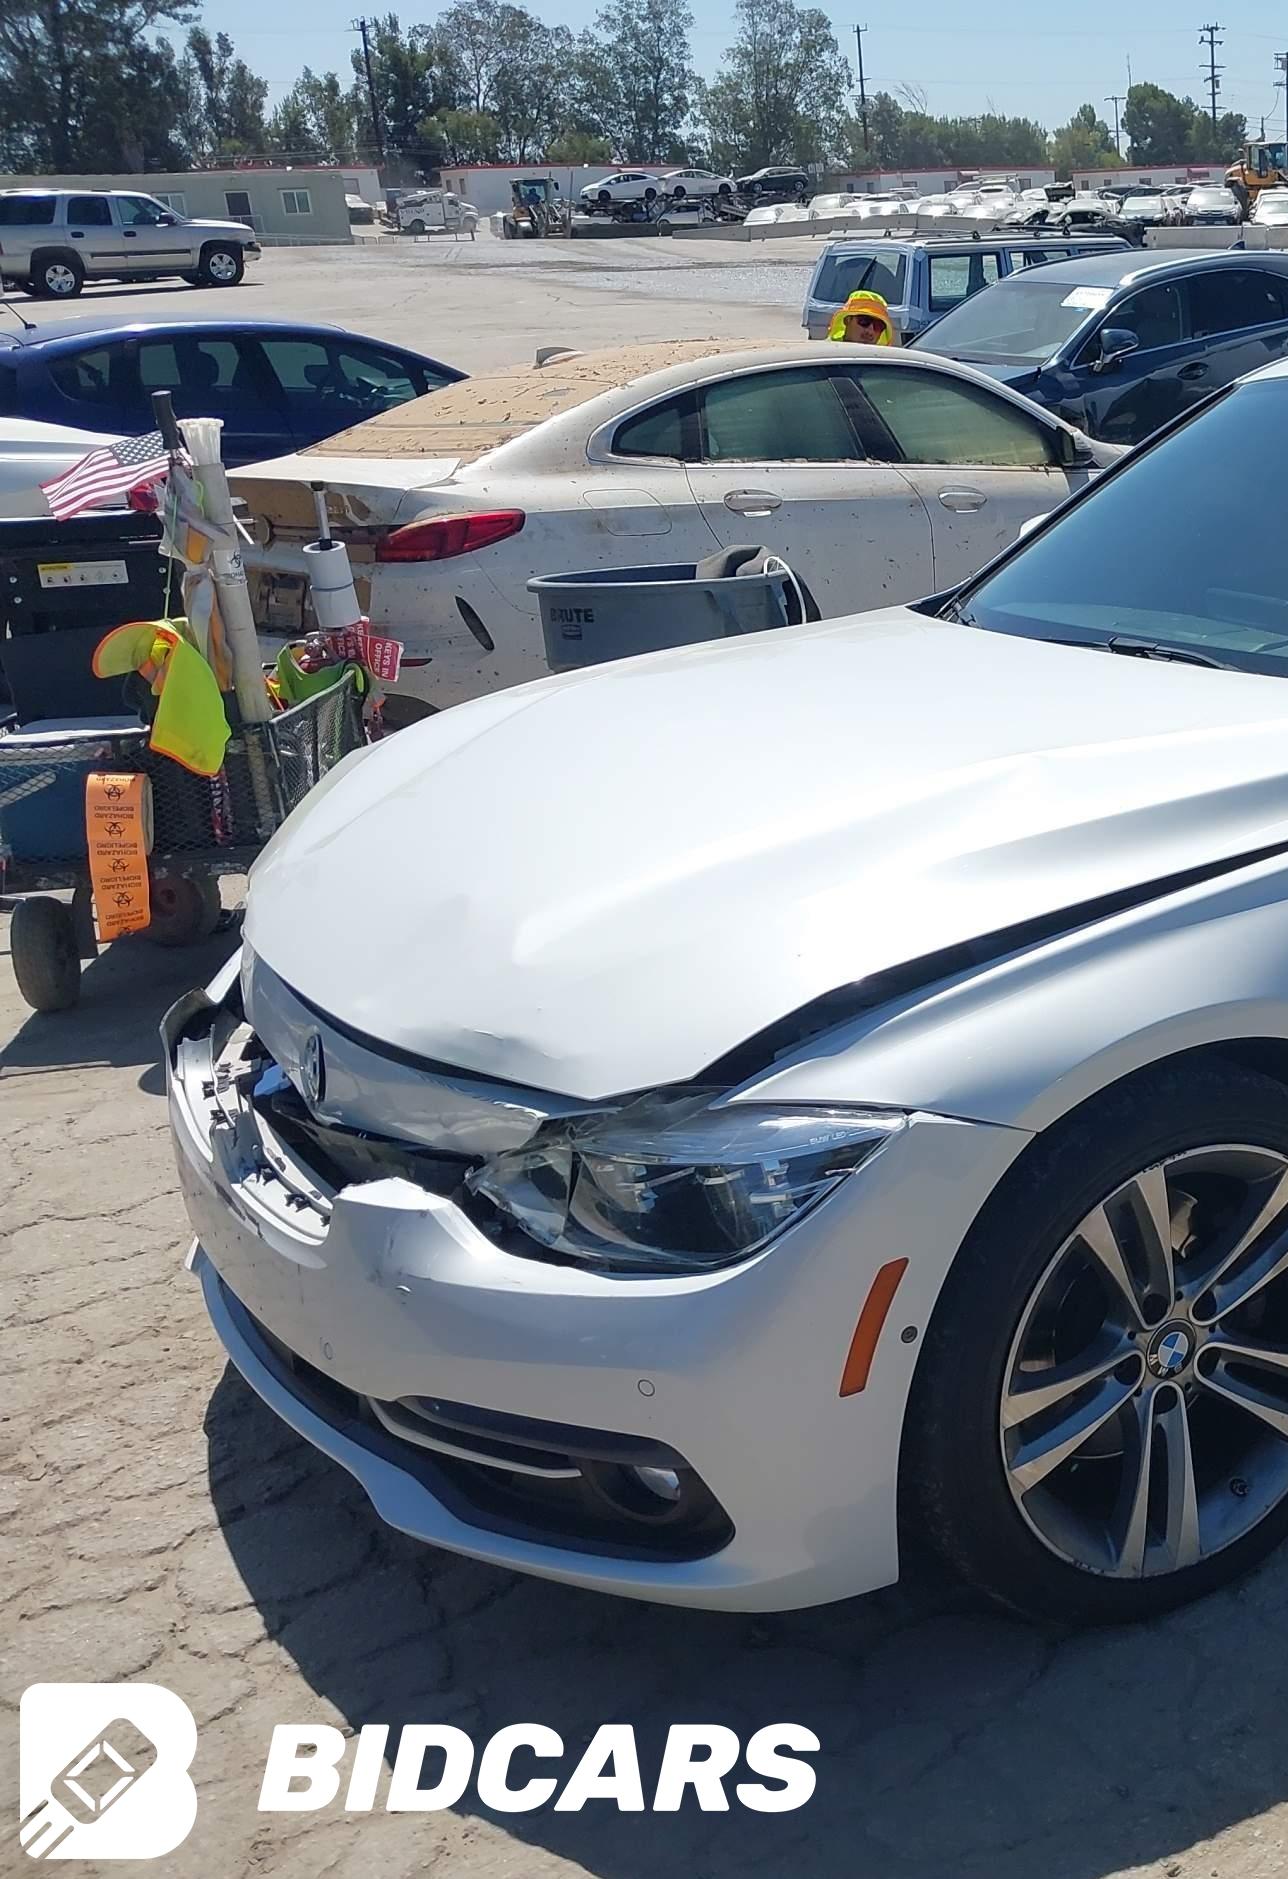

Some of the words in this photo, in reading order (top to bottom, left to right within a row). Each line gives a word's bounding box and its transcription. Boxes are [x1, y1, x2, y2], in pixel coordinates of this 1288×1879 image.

[550, 607, 595, 623] BRUTE
[374, 642, 383, 673] OFFICE
[383, 642, 393, 666] KEYS
[381, 667, 390, 678] IN
[101, 881, 142, 890] BIOHAZARD
